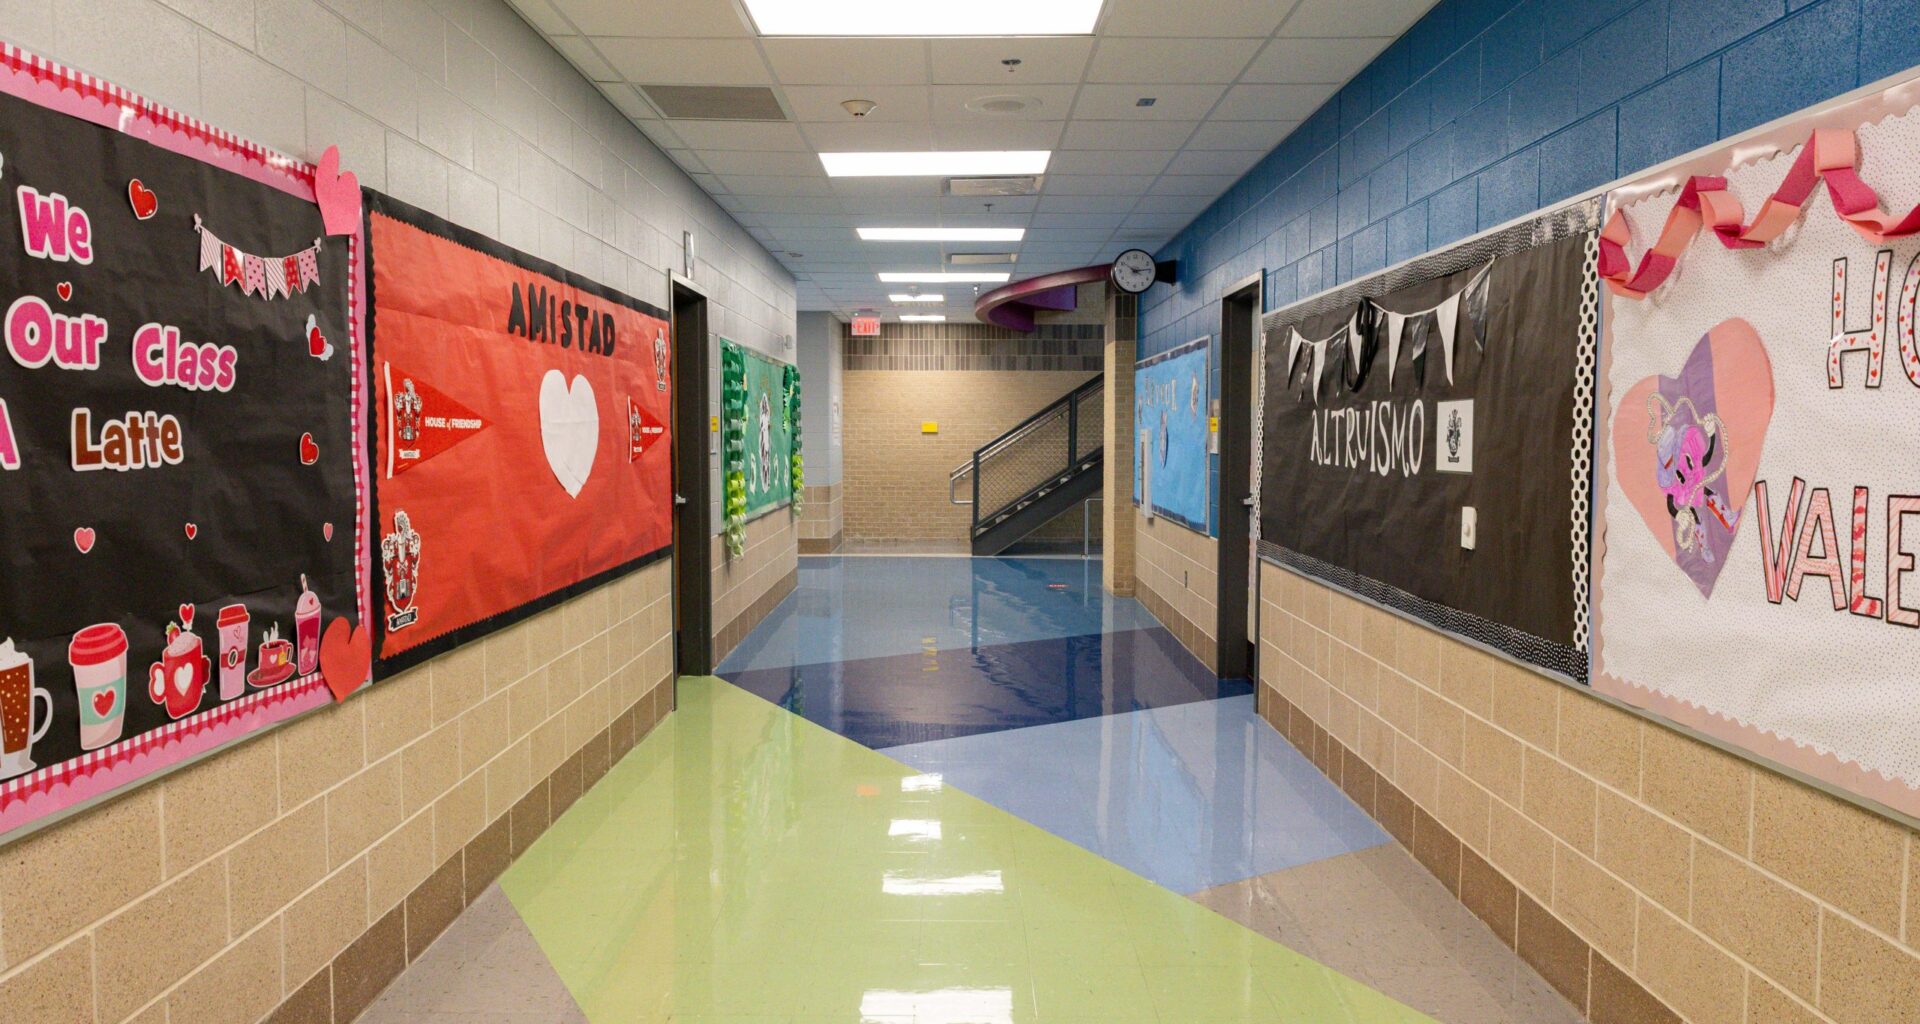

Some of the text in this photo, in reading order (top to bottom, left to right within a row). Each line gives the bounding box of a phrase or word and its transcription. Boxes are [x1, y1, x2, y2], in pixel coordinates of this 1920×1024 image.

[17, 185, 93, 264] We
[5, 295, 238, 392] Our Class
[508, 282, 615, 357] AMISTAD
[856, 318, 875, 334] EXIT
[71, 407, 184, 471] Latte
[425, 416, 446, 428] HOUSE
[1310, 399, 1424, 478] ALTRUISMO
